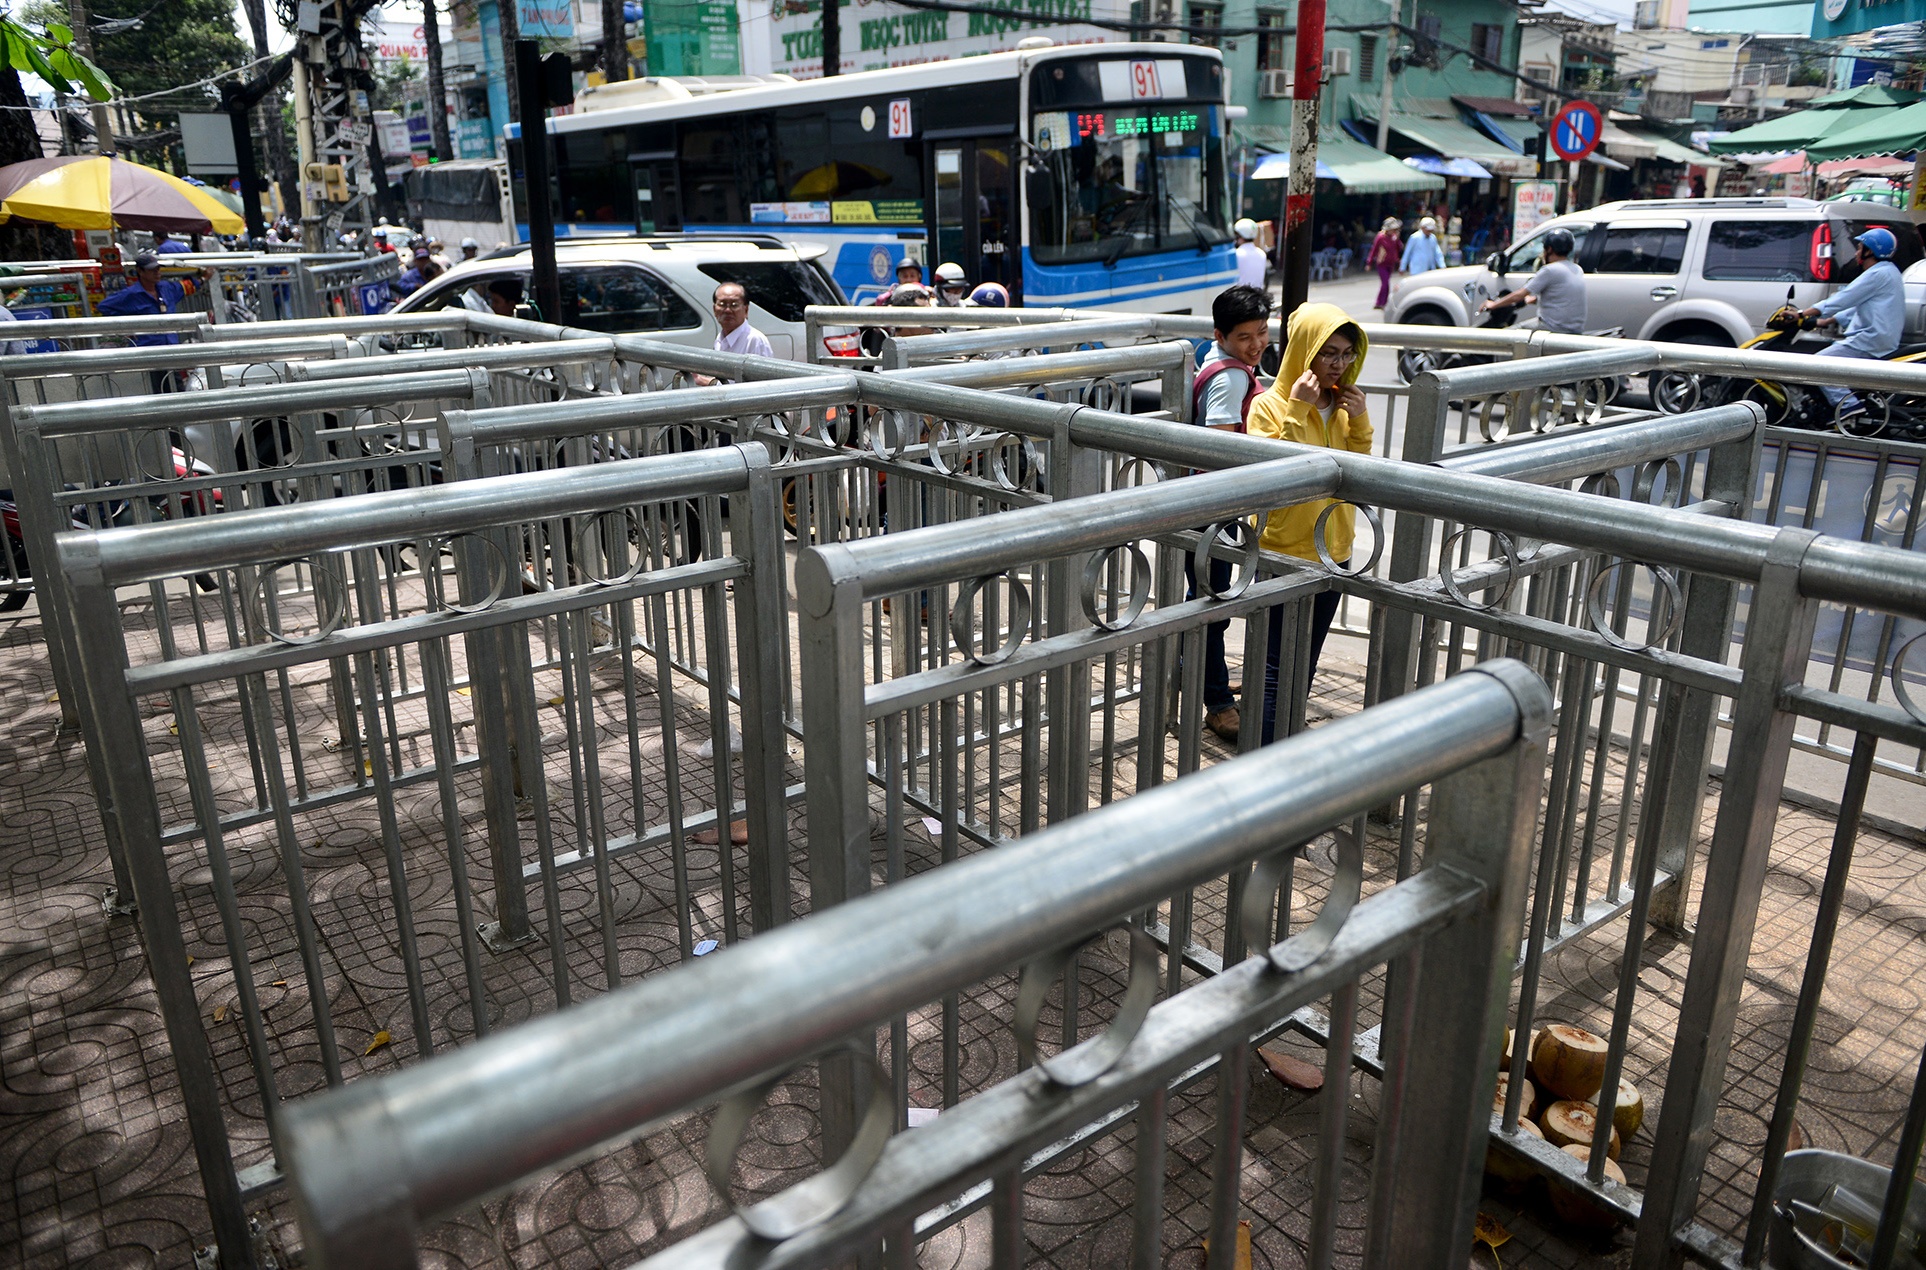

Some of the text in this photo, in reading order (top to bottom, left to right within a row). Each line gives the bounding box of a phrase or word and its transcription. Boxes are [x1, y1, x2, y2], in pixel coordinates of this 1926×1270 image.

[379, 43, 419, 59] QUANG
[860, 14, 900, 55] NGỌC
[1134, 62, 1158, 97] 91
[892, 102, 909, 135] 91
